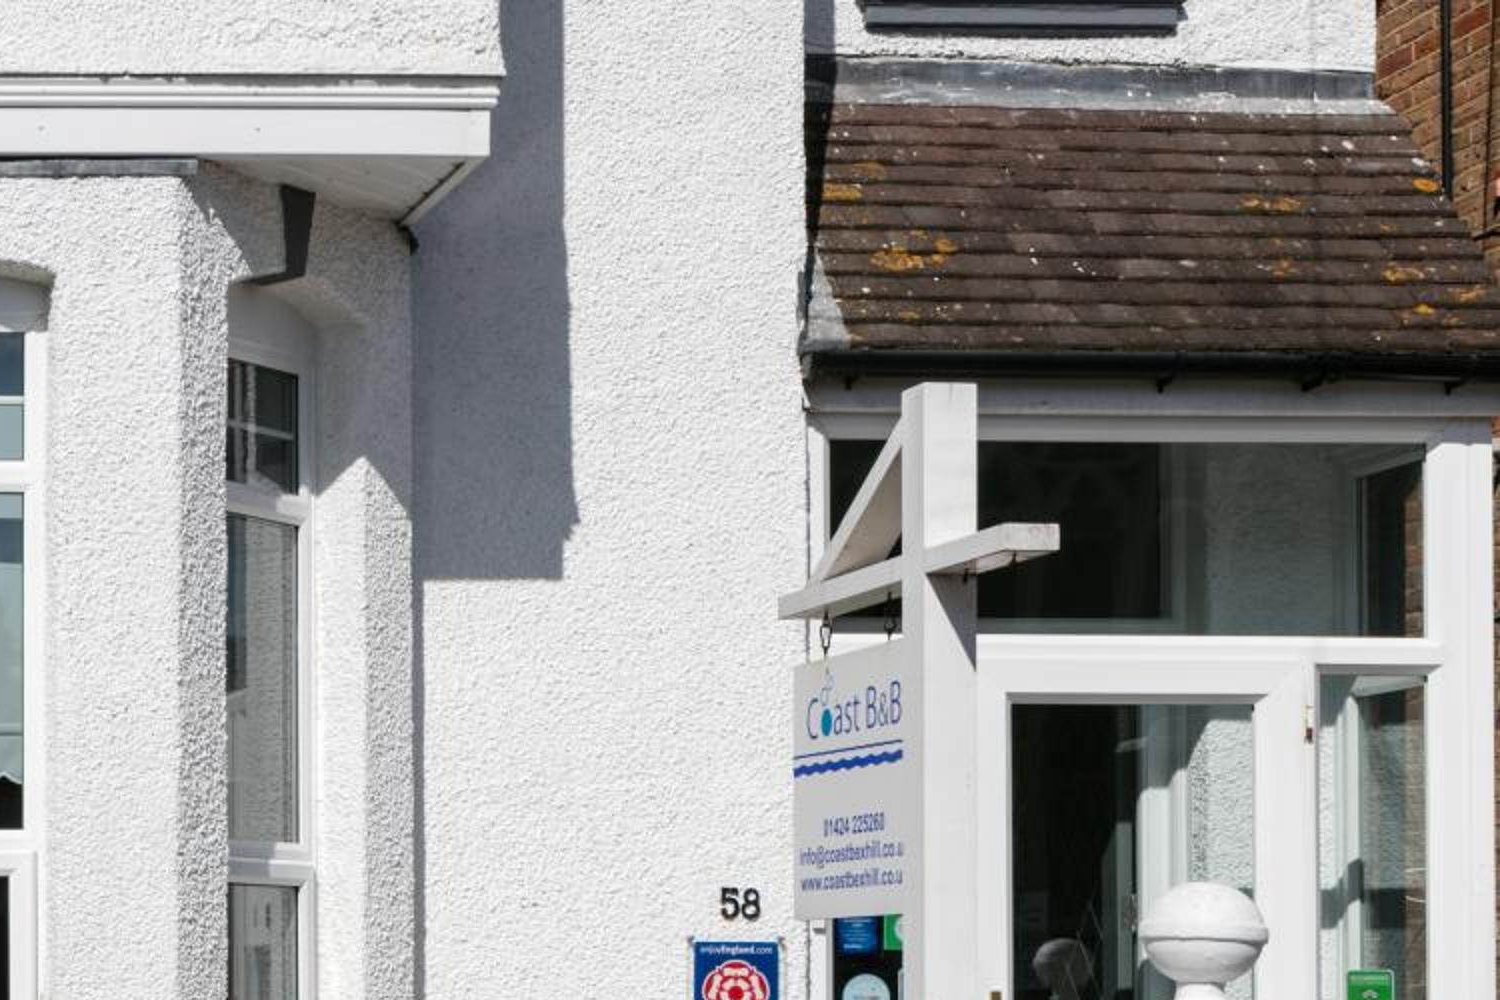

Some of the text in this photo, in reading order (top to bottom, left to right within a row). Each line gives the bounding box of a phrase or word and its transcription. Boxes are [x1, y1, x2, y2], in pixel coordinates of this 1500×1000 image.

[807, 680, 902, 740] Coast B&B
[823, 816, 850, 838] 01424
[801, 868, 903, 891] www.coastbexhill.co.u
[720, 887, 762, 921] 58
